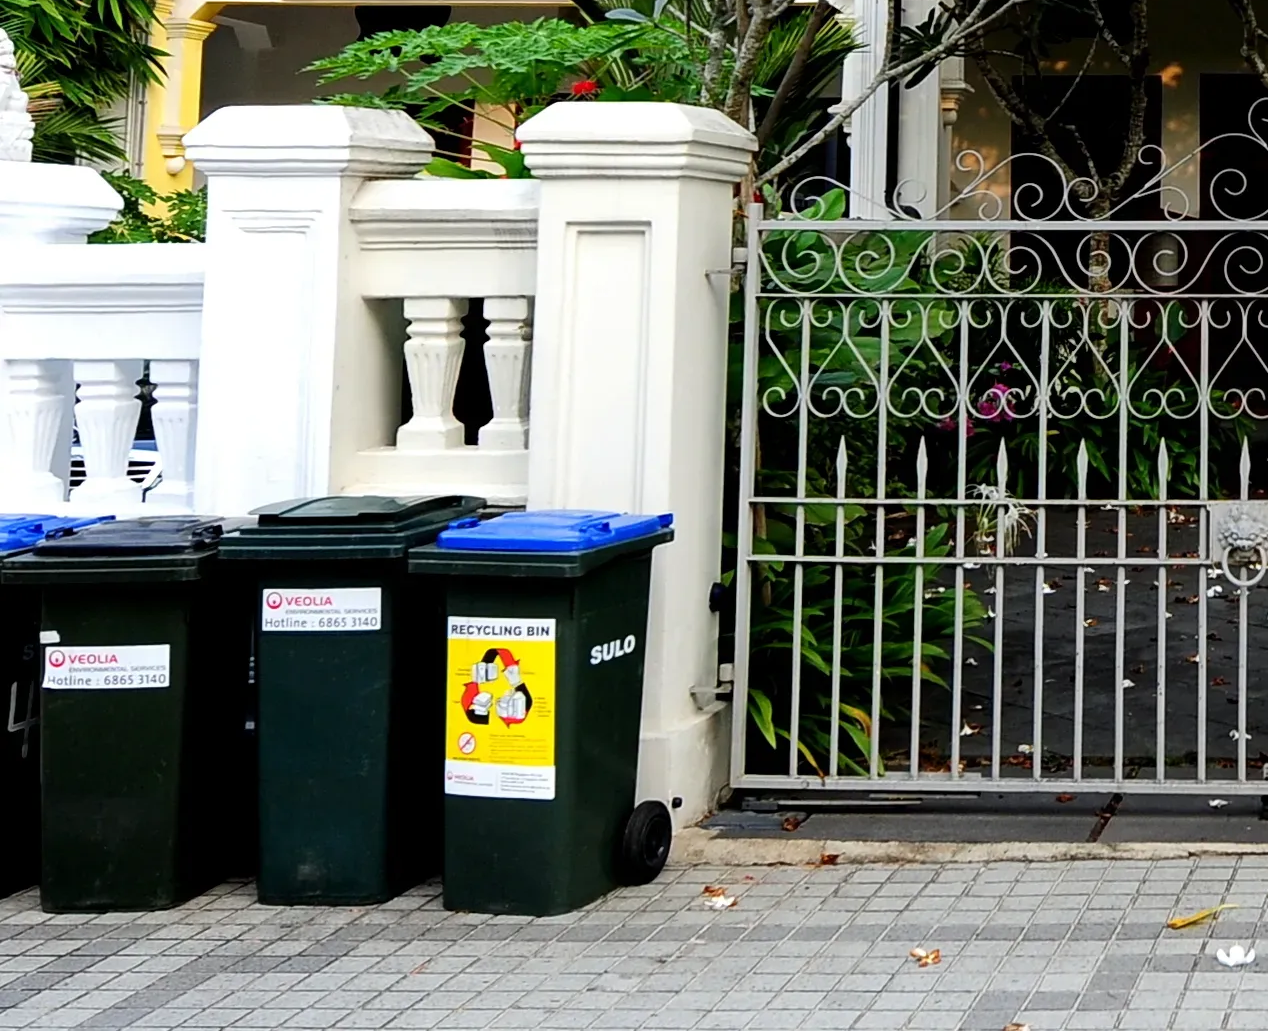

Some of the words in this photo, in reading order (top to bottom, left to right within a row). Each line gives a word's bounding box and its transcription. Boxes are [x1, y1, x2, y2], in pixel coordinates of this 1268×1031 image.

[285, 596, 333, 606] VEOLIA
[264, 617, 308, 628] Hotline
[318, 617, 347, 628] 6865
[351, 616, 378, 627] 3140
[451, 624, 522, 636] RECYCLING
[527, 626, 550, 637] BIN
[590, 634, 637, 666] SULO
[68, 654, 118, 664] VEOLIA
[47, 675, 92, 686] Hotline
[104, 675, 134, 686] 6865
[138, 674, 167, 685] 3140
